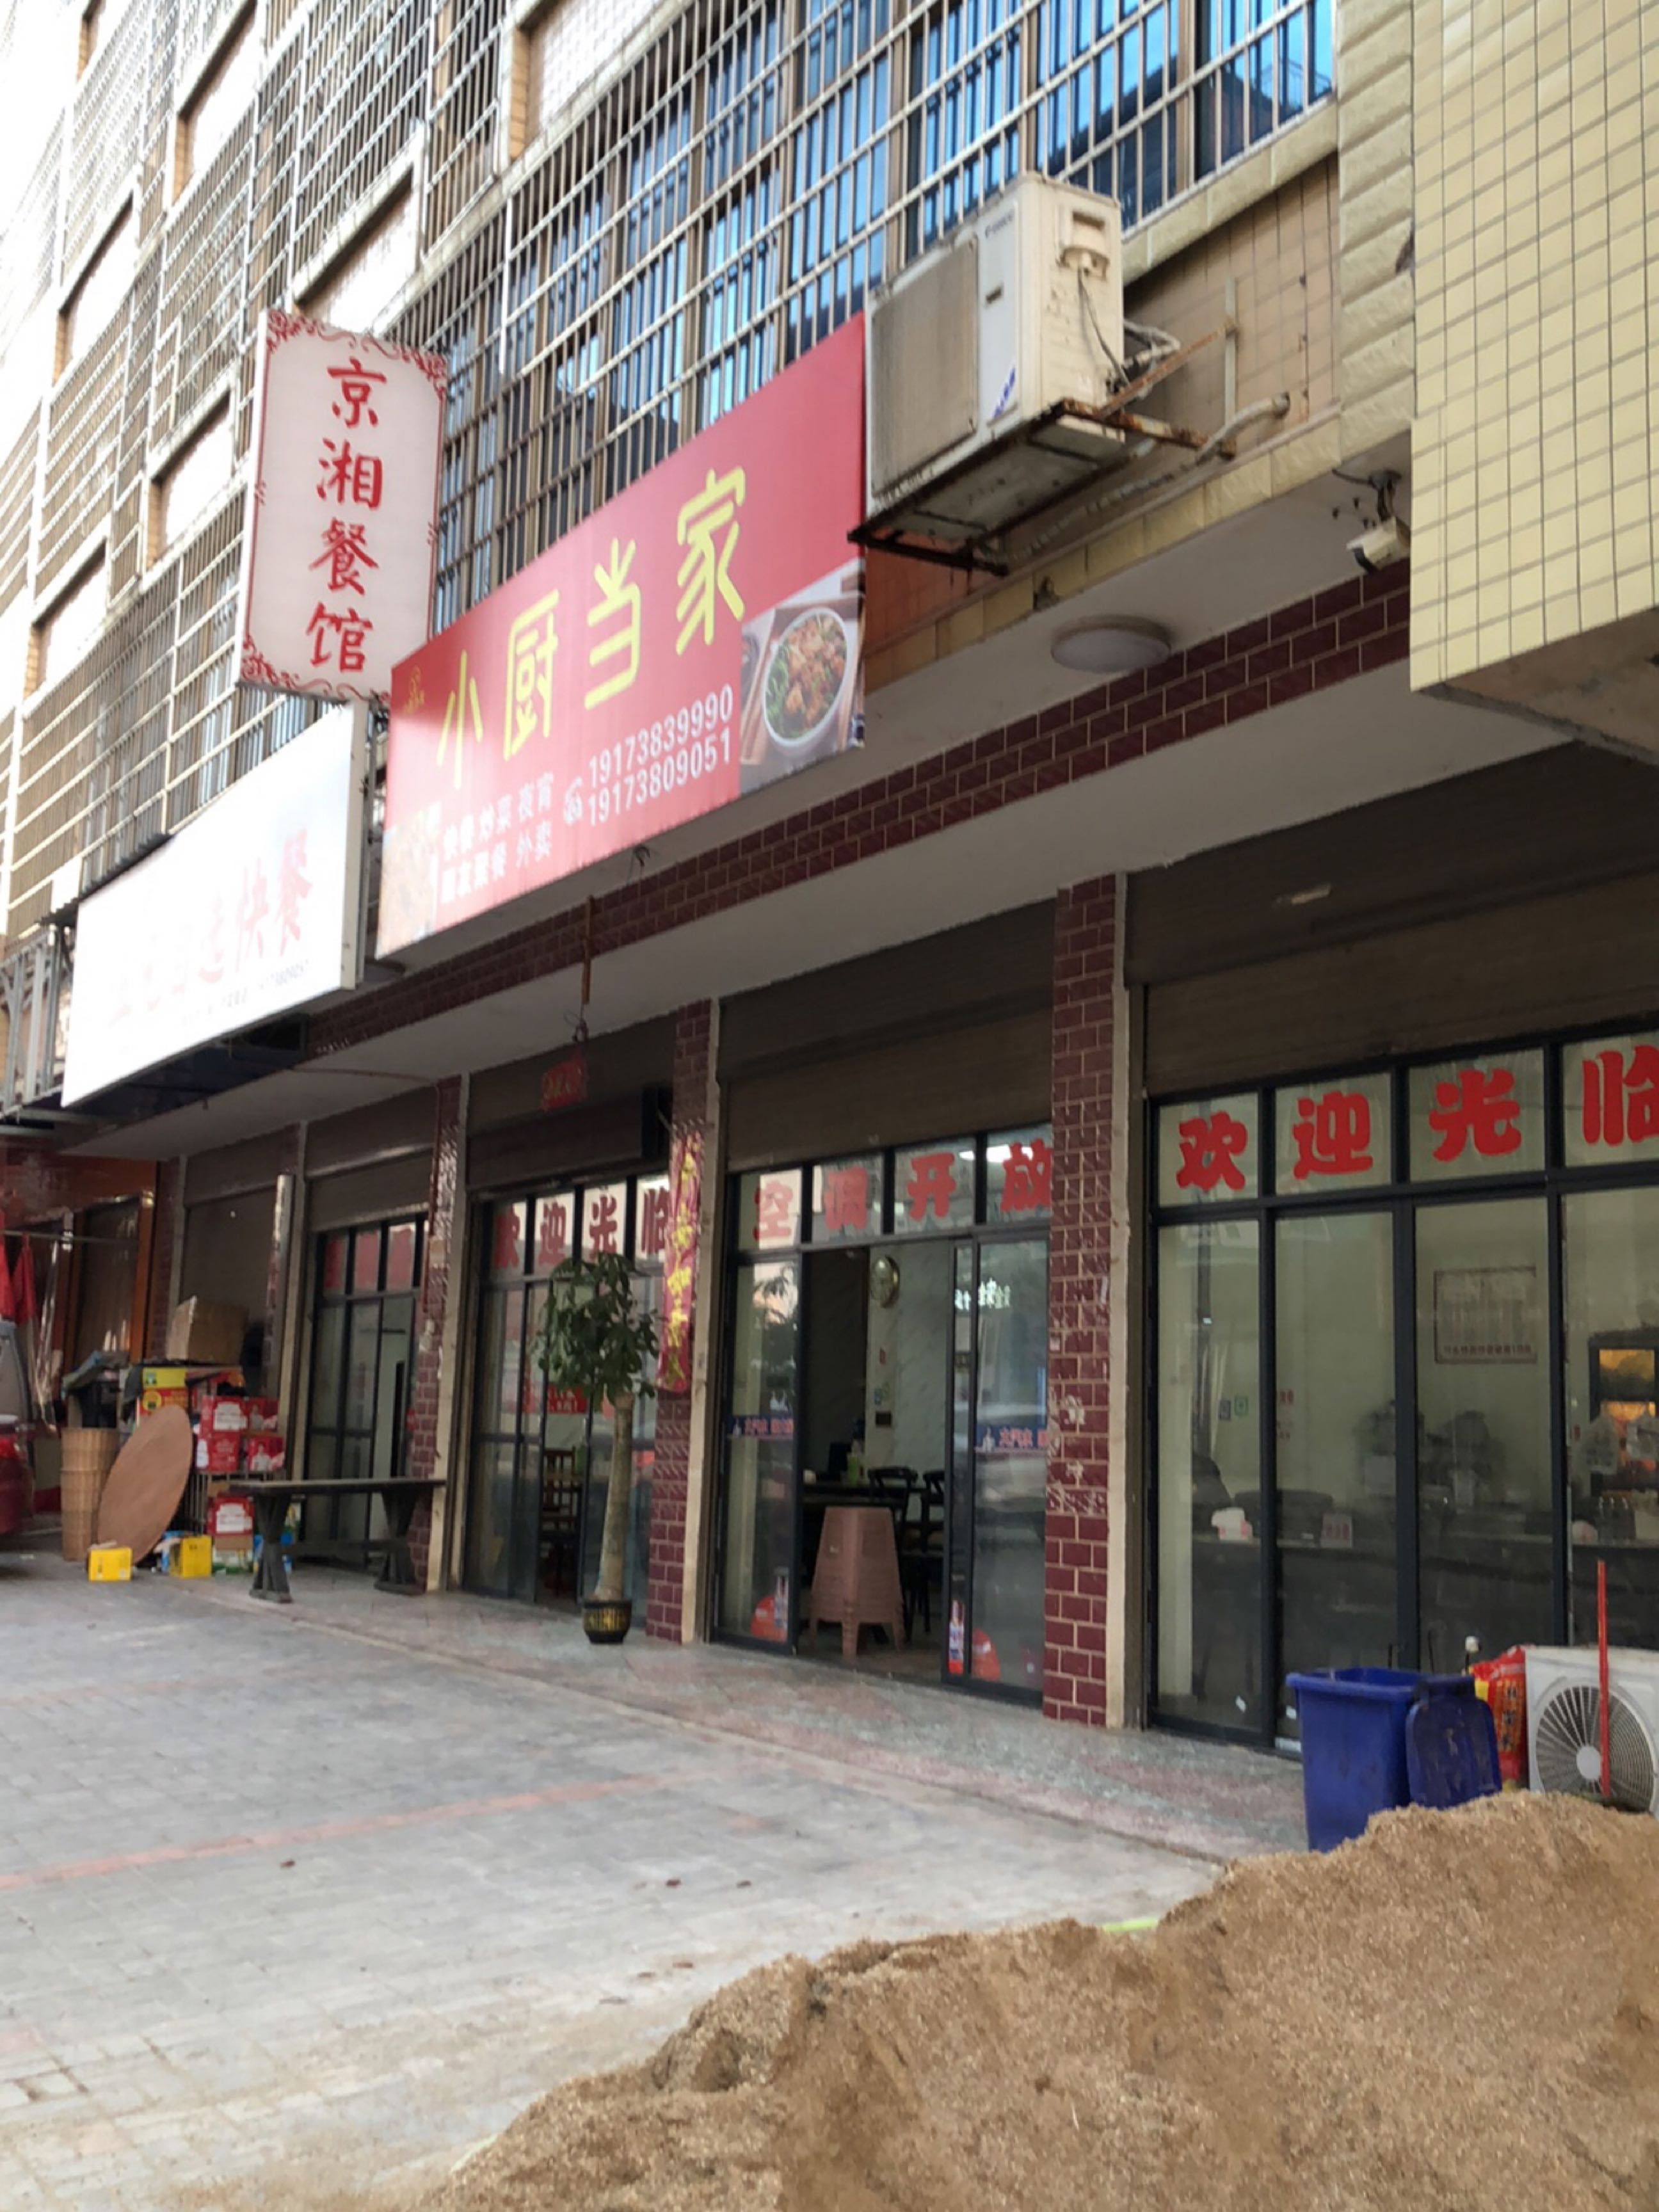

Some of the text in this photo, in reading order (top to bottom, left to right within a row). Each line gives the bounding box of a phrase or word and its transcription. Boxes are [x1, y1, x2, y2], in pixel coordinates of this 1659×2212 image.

[306, 357, 387, 673] 京湘餐馆
[436, 467, 747, 790] 小厨当家
[588, 726, 730, 827] 19173809051
[589, 683, 733, 789] 19173839990
[1176, 1045, 1659, 1192] 欢迎光临
[752, 1138, 1052, 1242] 空调开放
